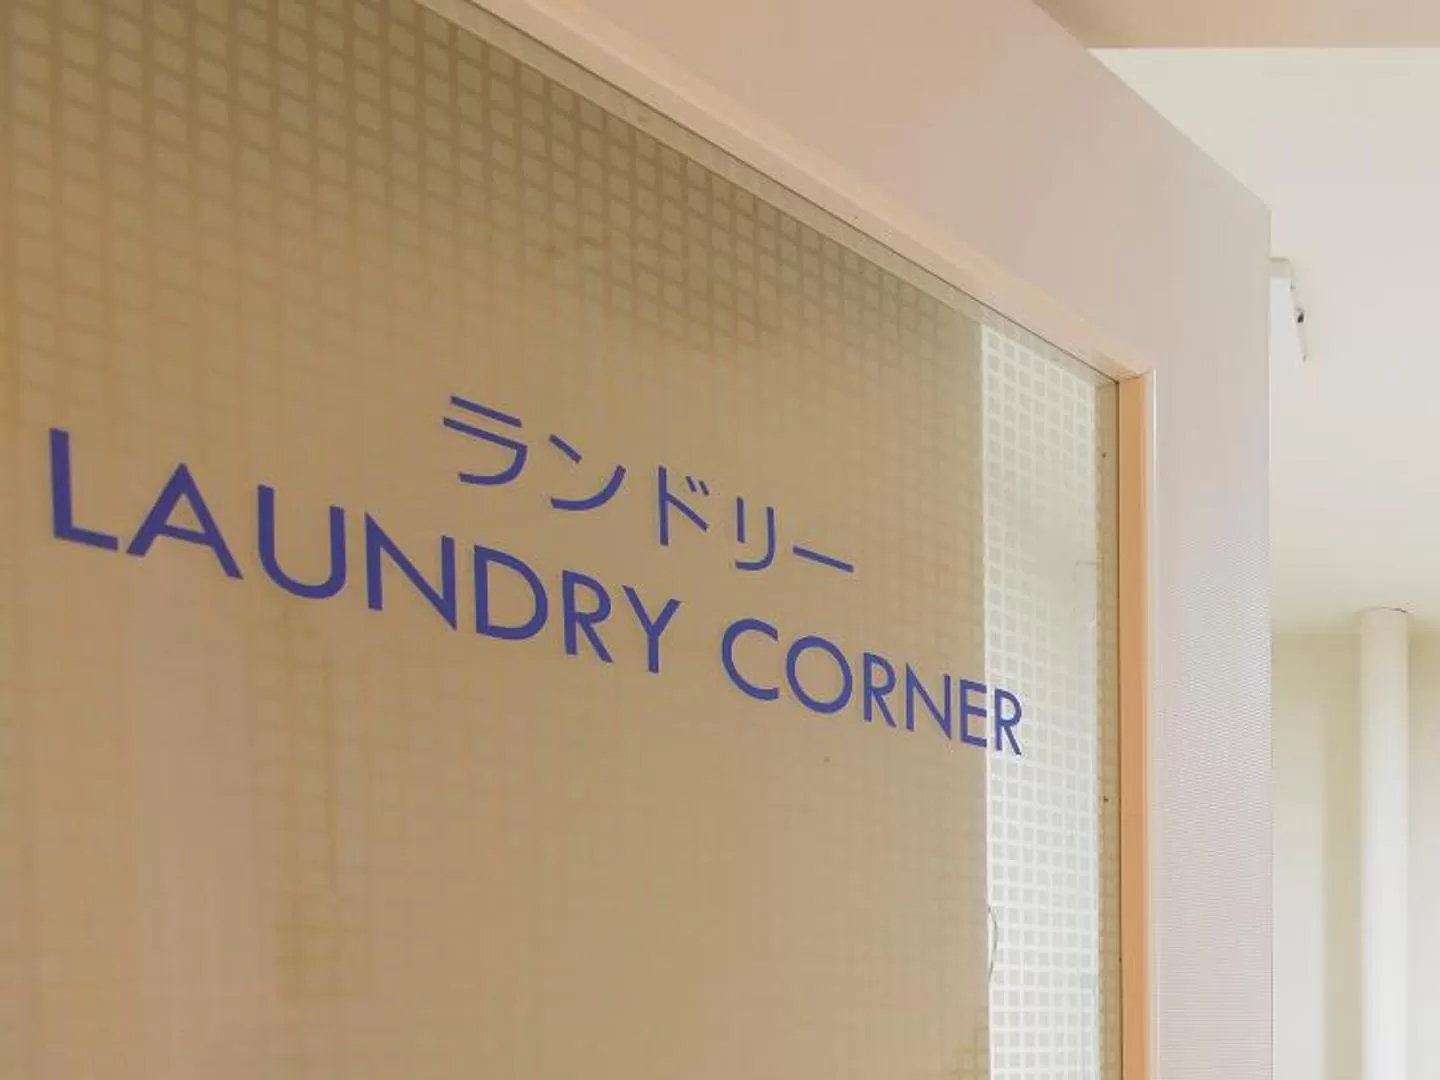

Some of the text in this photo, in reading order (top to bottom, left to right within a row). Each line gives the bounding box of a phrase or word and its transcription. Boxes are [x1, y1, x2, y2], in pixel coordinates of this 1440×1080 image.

[49, 427, 1023, 756] LAUNDRY CORNER
[442, 395, 856, 574] ランドリー
